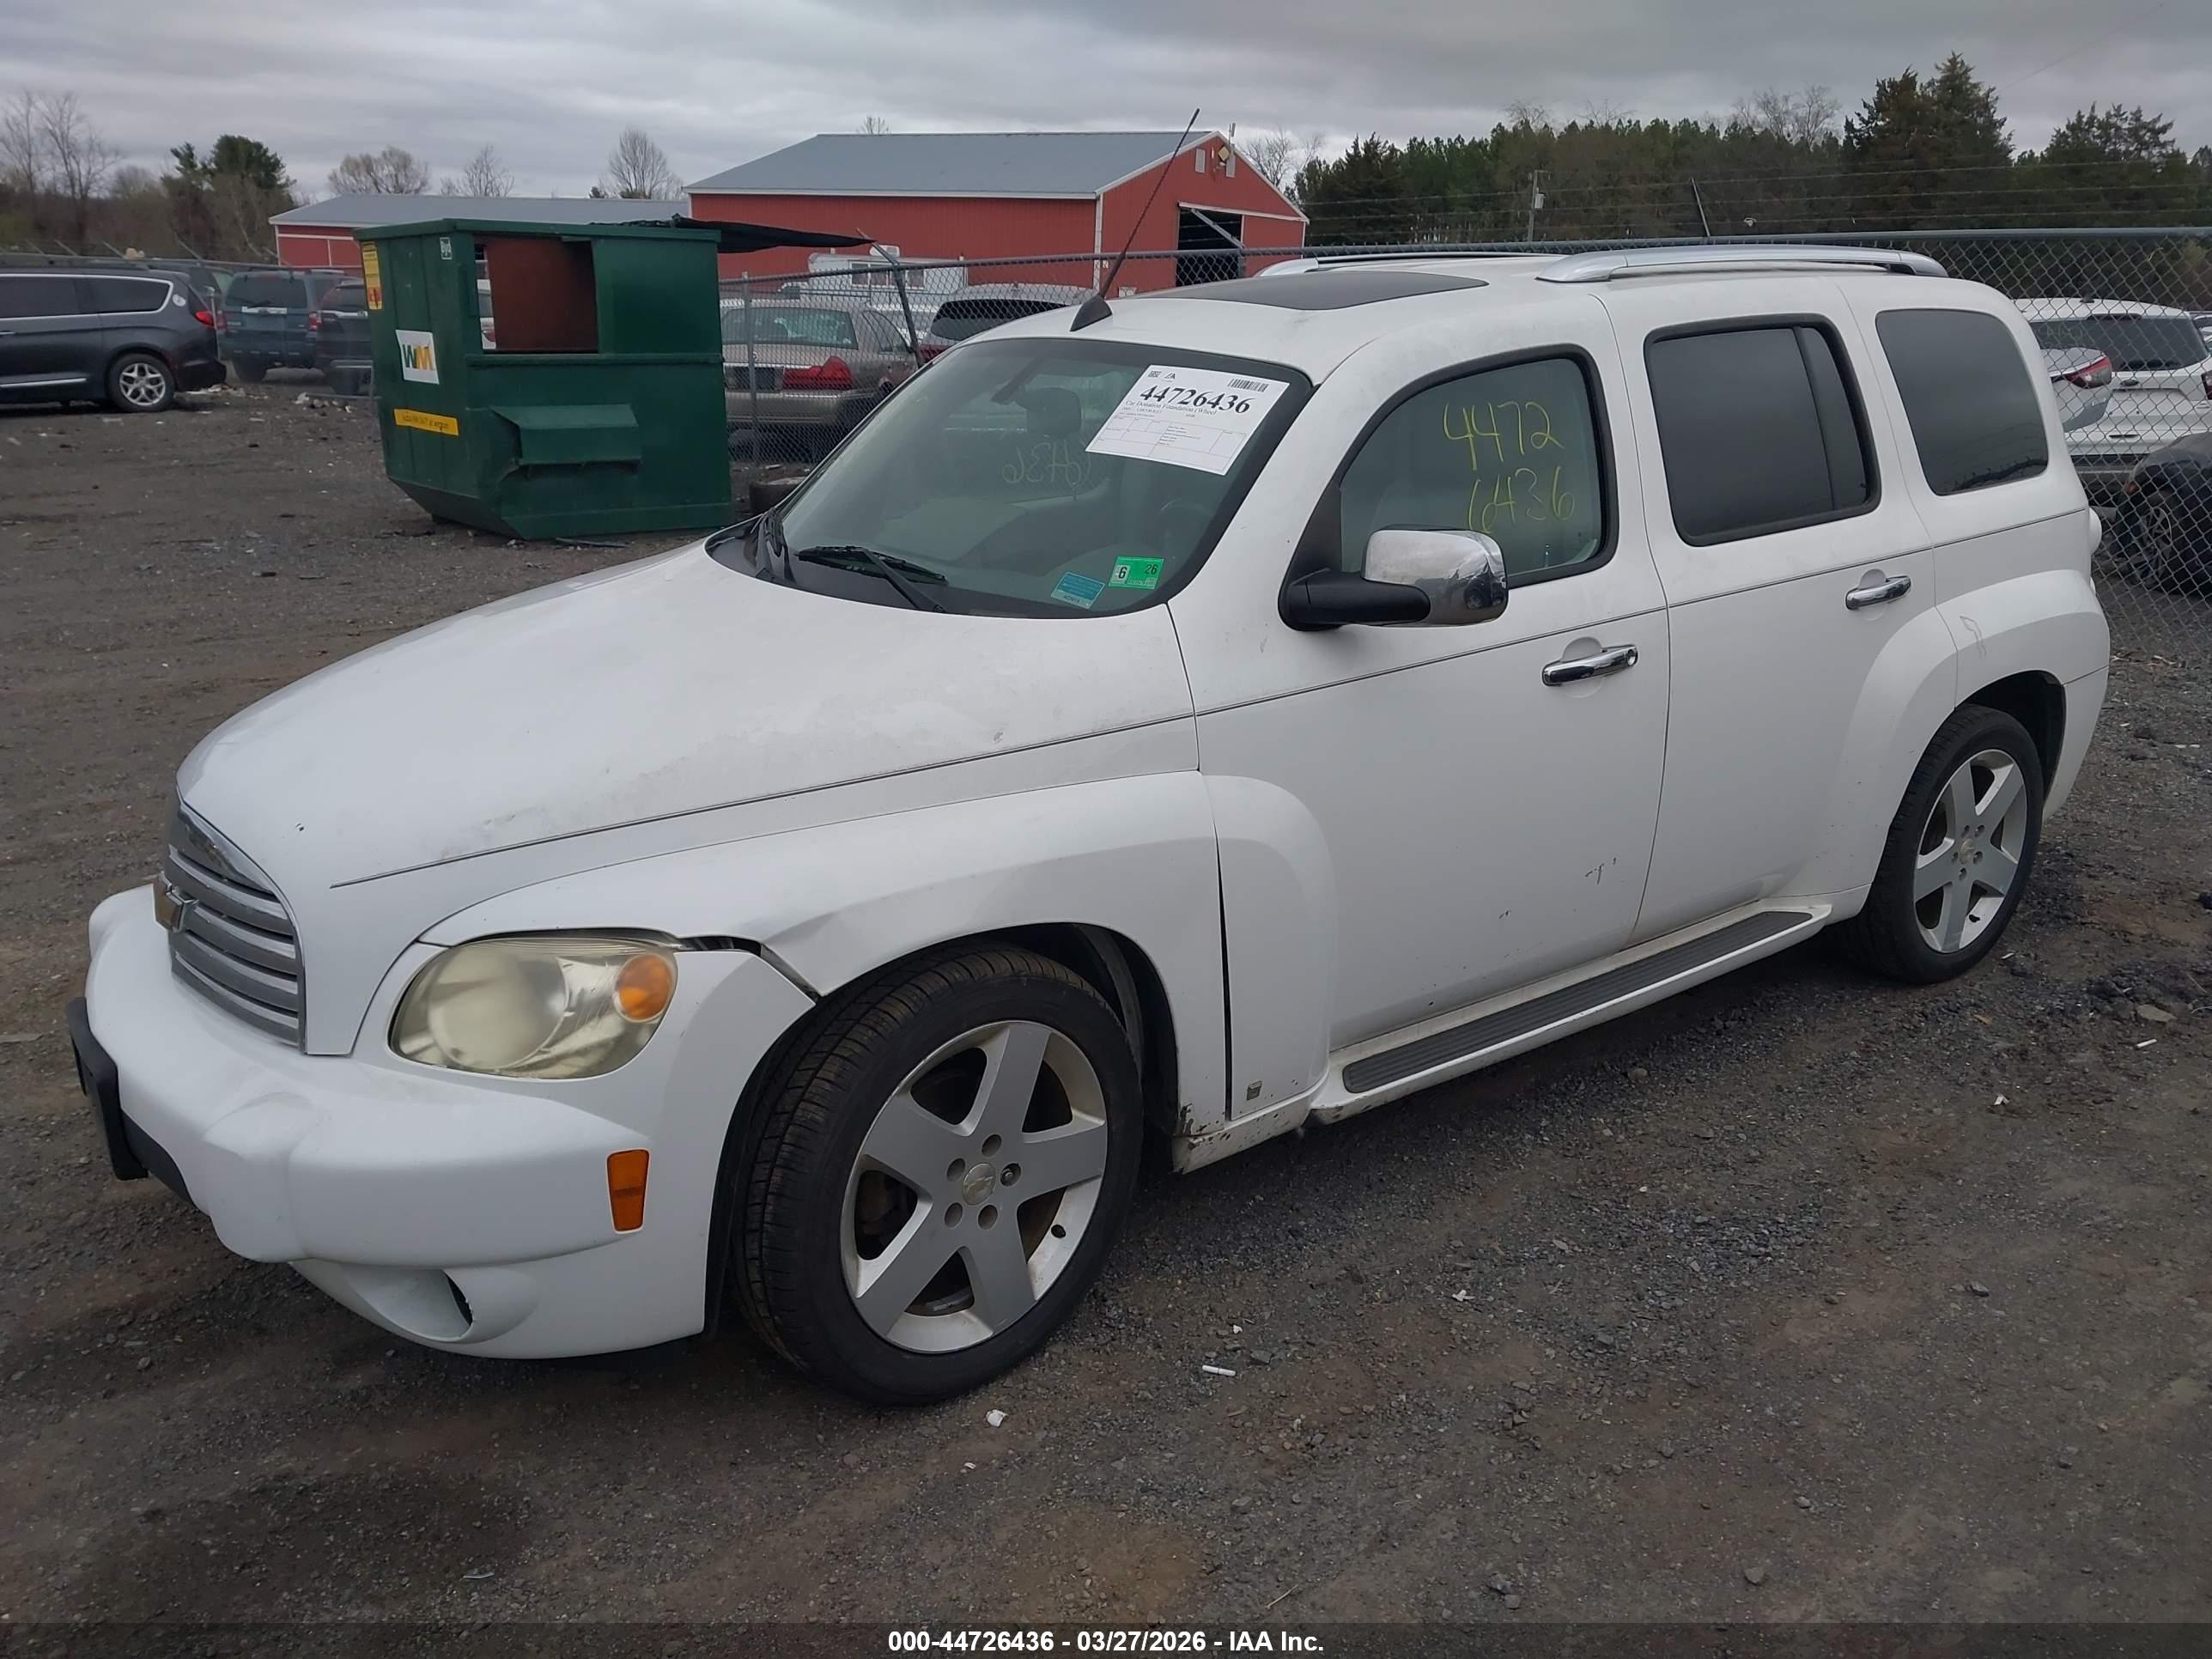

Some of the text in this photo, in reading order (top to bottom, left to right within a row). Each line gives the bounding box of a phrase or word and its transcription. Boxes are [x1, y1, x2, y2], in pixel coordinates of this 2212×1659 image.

[402, 344, 435, 371] WM
[1139, 385, 1256, 414] 44726436
[1162, 404, 1194, 412] Foundation
[1443, 401, 1565, 471] 4472
[1468, 465, 1575, 534] 6436
[1118, 564, 1158, 579] 6 26
